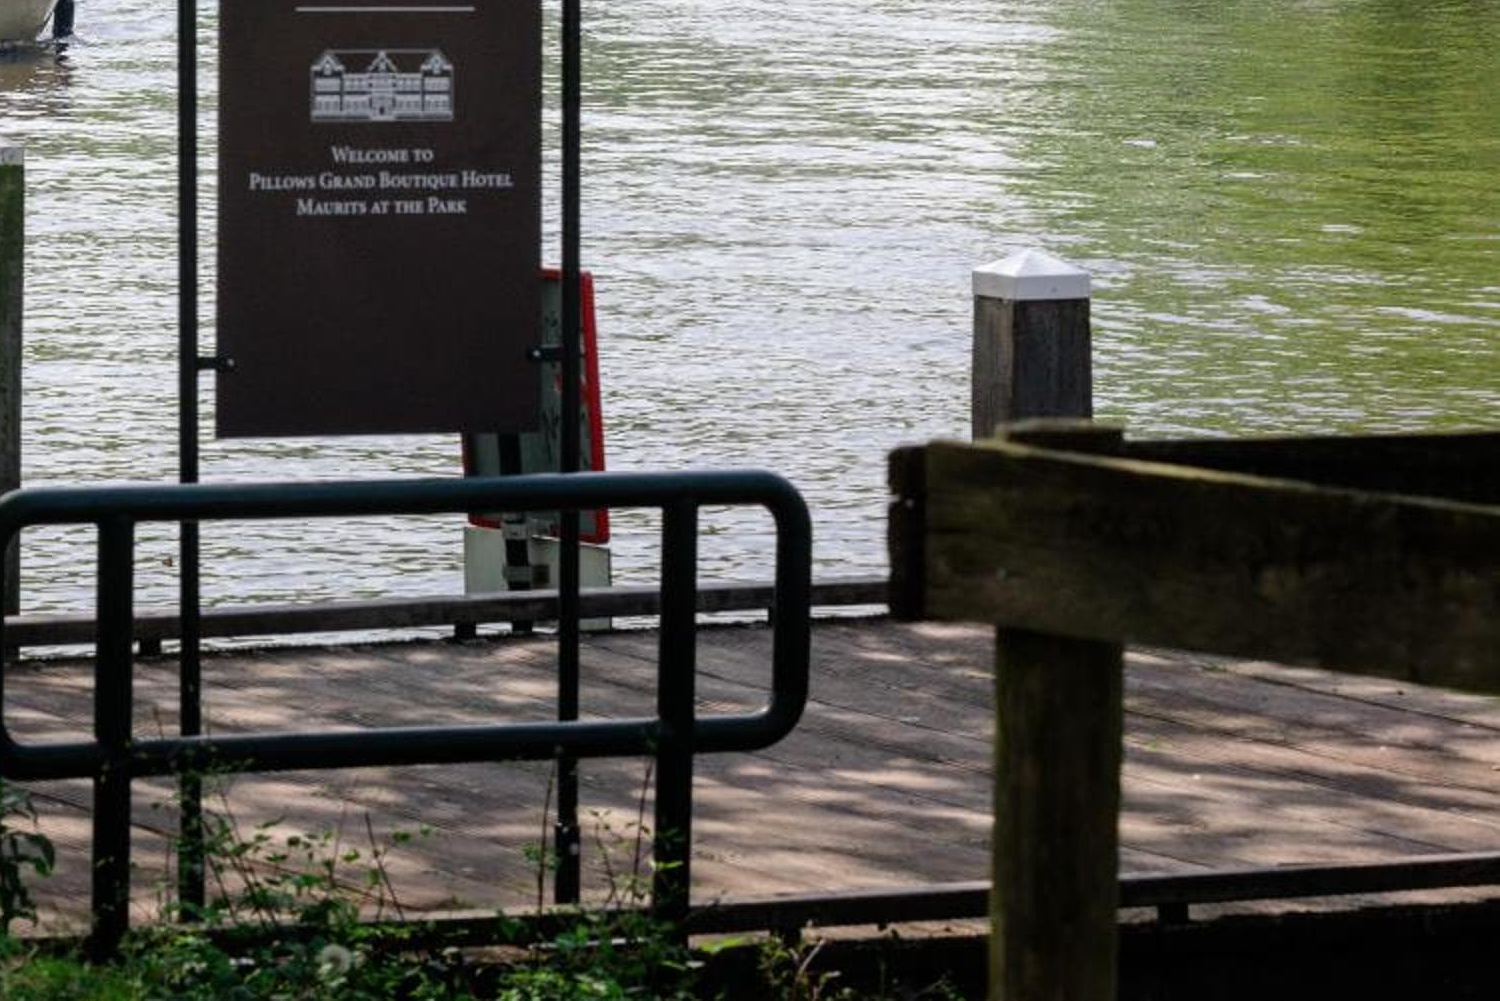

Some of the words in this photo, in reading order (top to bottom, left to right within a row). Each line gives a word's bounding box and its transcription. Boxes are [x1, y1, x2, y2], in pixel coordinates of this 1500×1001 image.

[331, 146, 409, 163] WELCOME
[249, 172, 316, 190] PILLOWS
[319, 171, 376, 189] GRAND
[379, 170, 458, 189] BOUTIQUE
[461, 170, 514, 187] HOTEL
[296, 198, 367, 215] MAURITS
[427, 196, 467, 214] PARK
